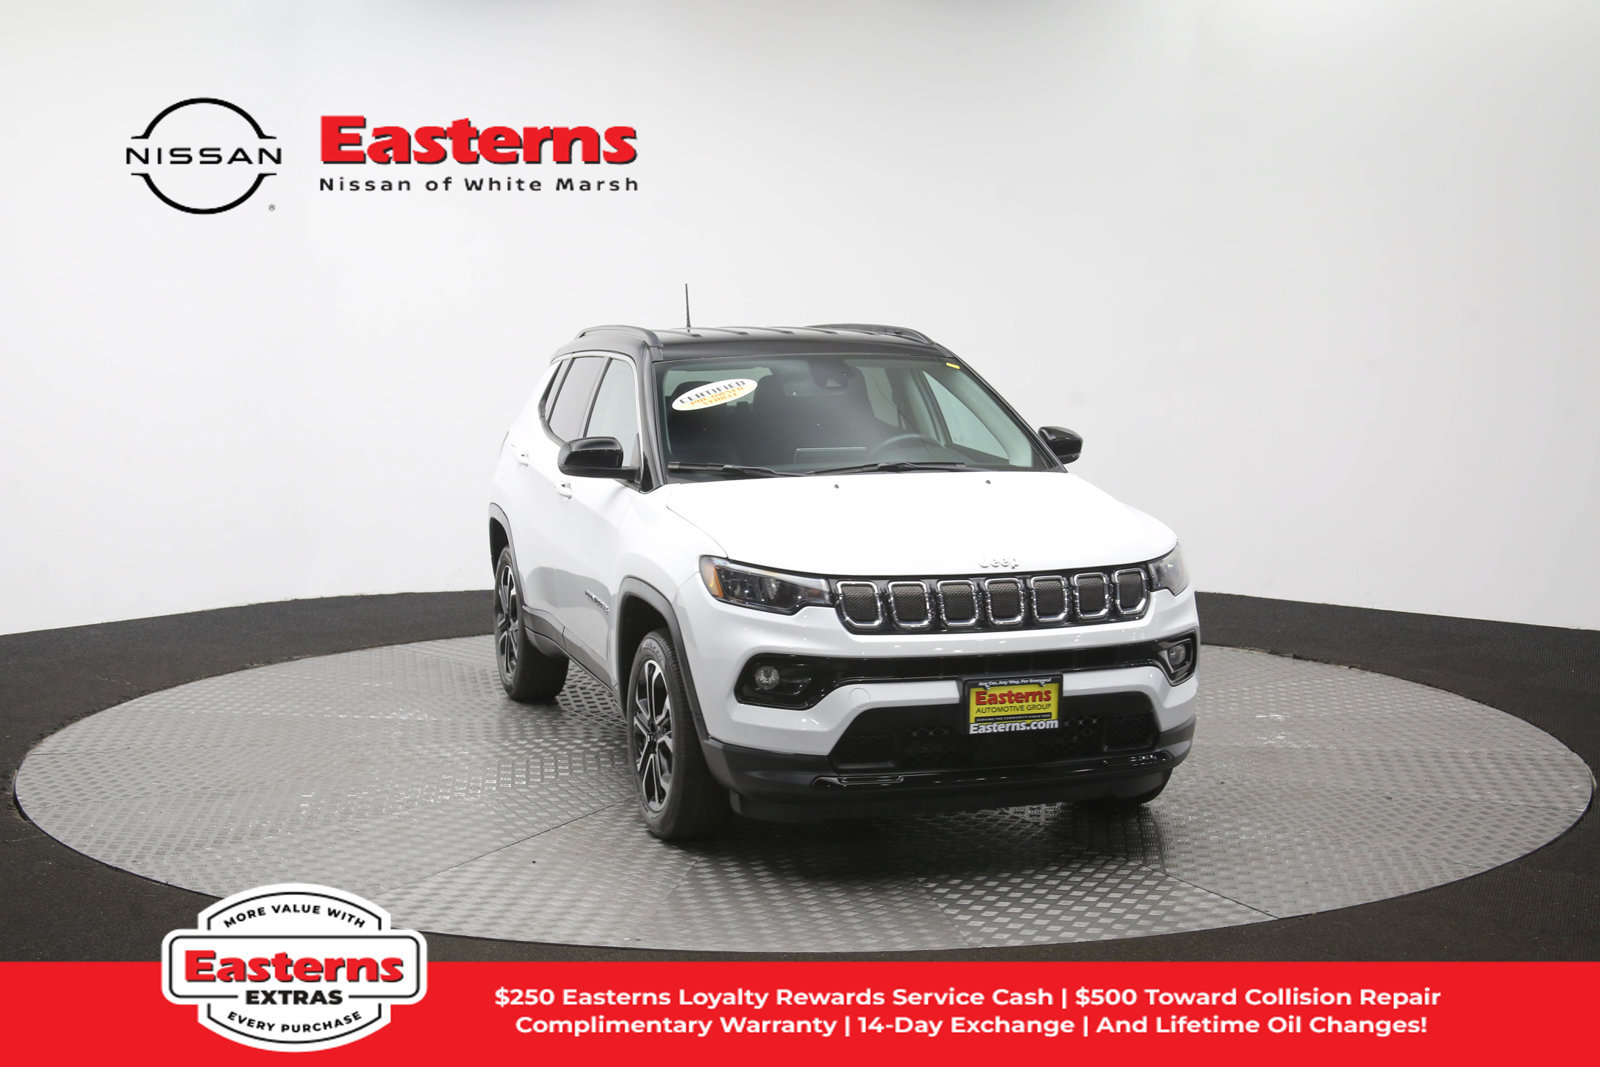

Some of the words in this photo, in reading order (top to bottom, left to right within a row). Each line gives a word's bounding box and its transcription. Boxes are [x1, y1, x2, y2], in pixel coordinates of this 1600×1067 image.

[679, 380, 746, 404] CERTIFIED
[975, 689, 1052, 705] Easterns
[976, 704, 1025, 714] AUTOMOTIVE
[1026, 703, 1052, 711] GROUP
[969, 719, 1059, 735] Easterns.com
